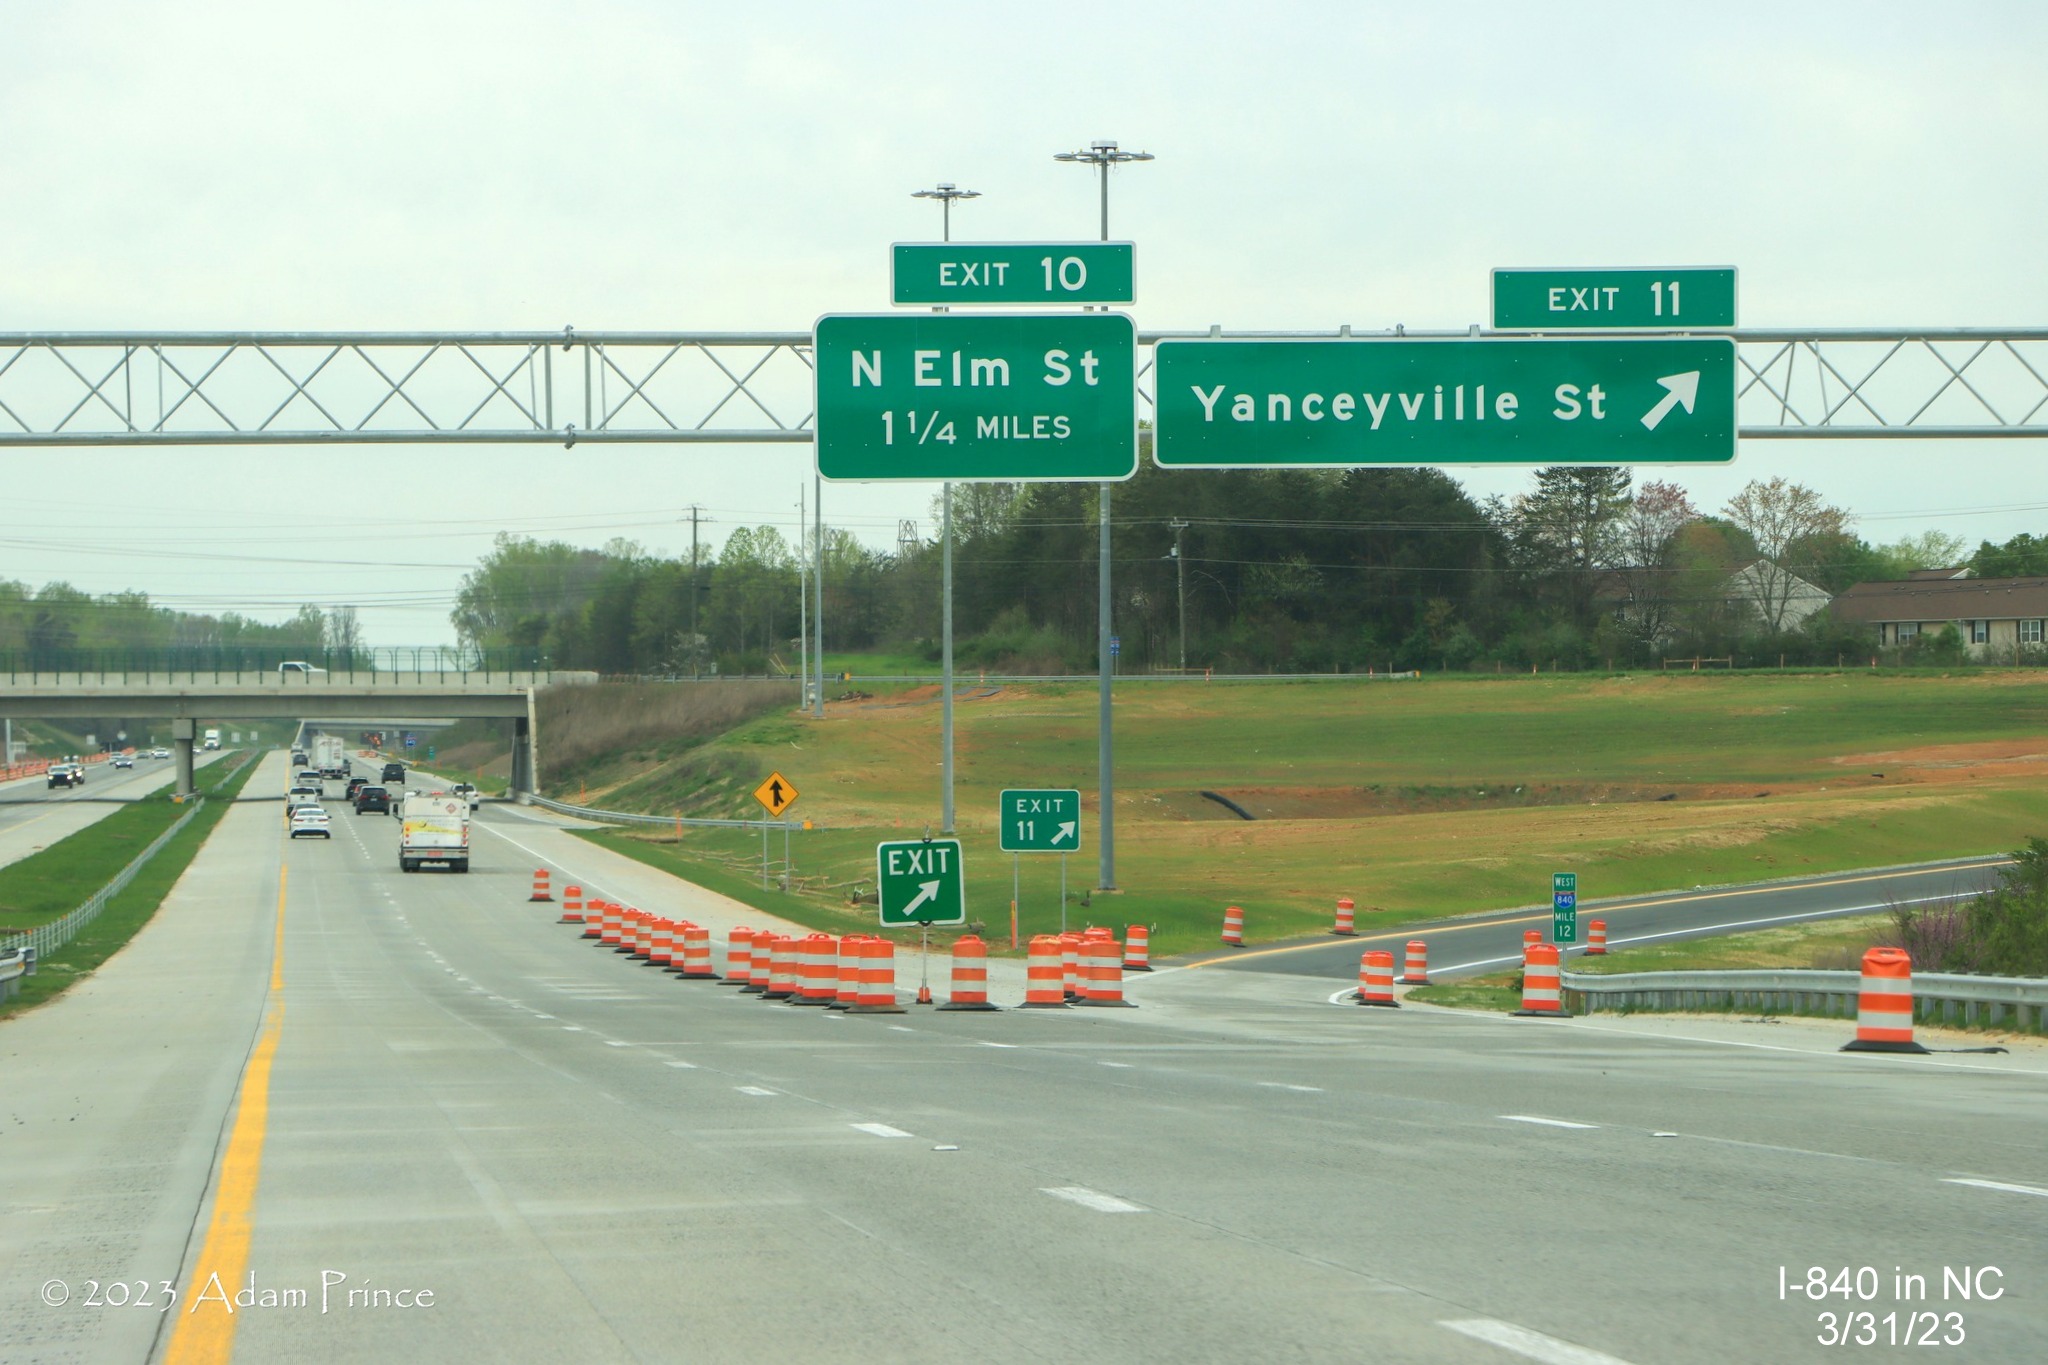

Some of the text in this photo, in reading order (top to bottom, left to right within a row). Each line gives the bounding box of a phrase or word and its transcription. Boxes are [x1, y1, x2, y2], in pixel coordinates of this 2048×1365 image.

[939, 256, 1087, 291] EXIT 10
[1549, 281, 1680, 316] EXIT 11
[851, 349, 1099, 387] N Elm St
[1191, 384, 1607, 430] Yanceyville St
[977, 415, 1071, 439] MILES
[1016, 798, 1064, 813] EXIT
[1017, 820, 1034, 841] 11
[888, 848, 951, 876] EXIT
[1555, 877, 1574, 886] WEST
[1557, 895, 1573, 904] 840
[1555, 912, 1575, 921] MILE
[1559, 925, 1571, 937] 12
